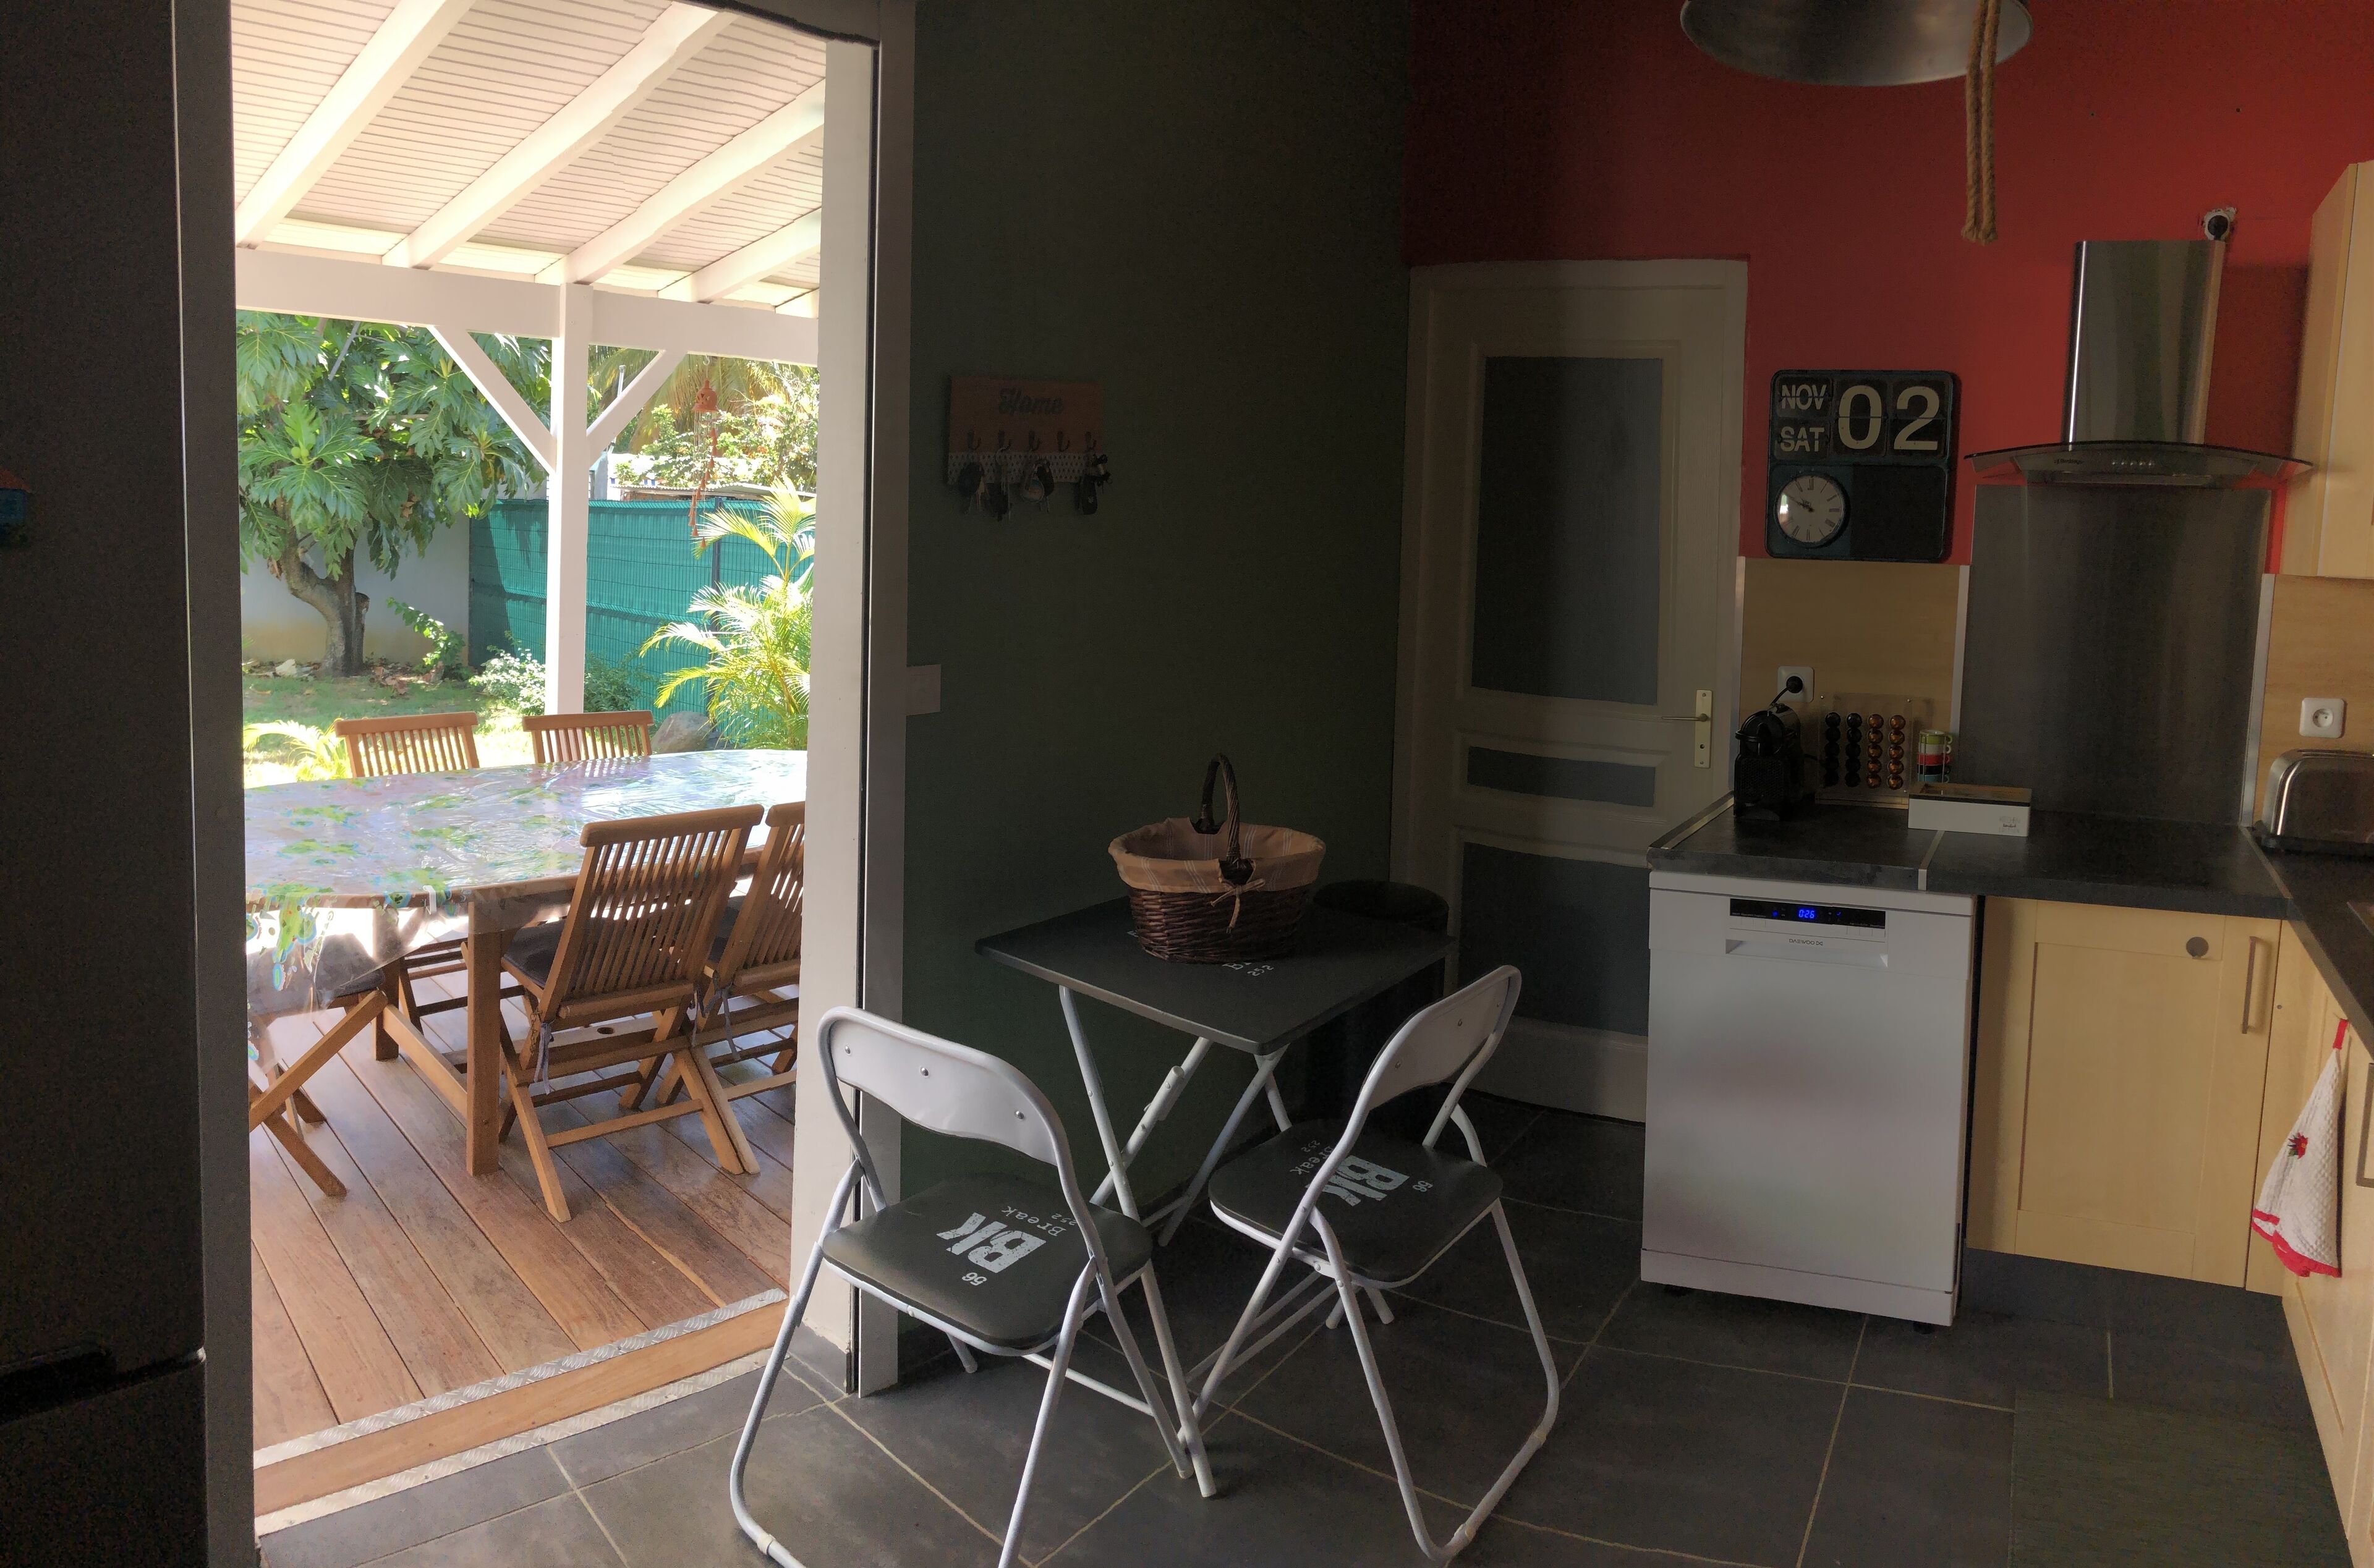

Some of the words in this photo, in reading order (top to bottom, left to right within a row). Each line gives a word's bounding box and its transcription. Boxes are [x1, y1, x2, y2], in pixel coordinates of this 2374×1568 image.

[1781, 384, 1827, 410] NOV
[1838, 384, 1940, 451] 02
[1780, 426, 1824, 452] SAT
[1247, 965, 1274, 976] 252
[1300, 1140, 1320, 1152] 252
[1412, 1180, 1434, 1192] 56
[1002, 1206, 1067, 1237] Break
[1051, 1213, 1078, 1226] 252
[961, 1272, 987, 1286] 56
